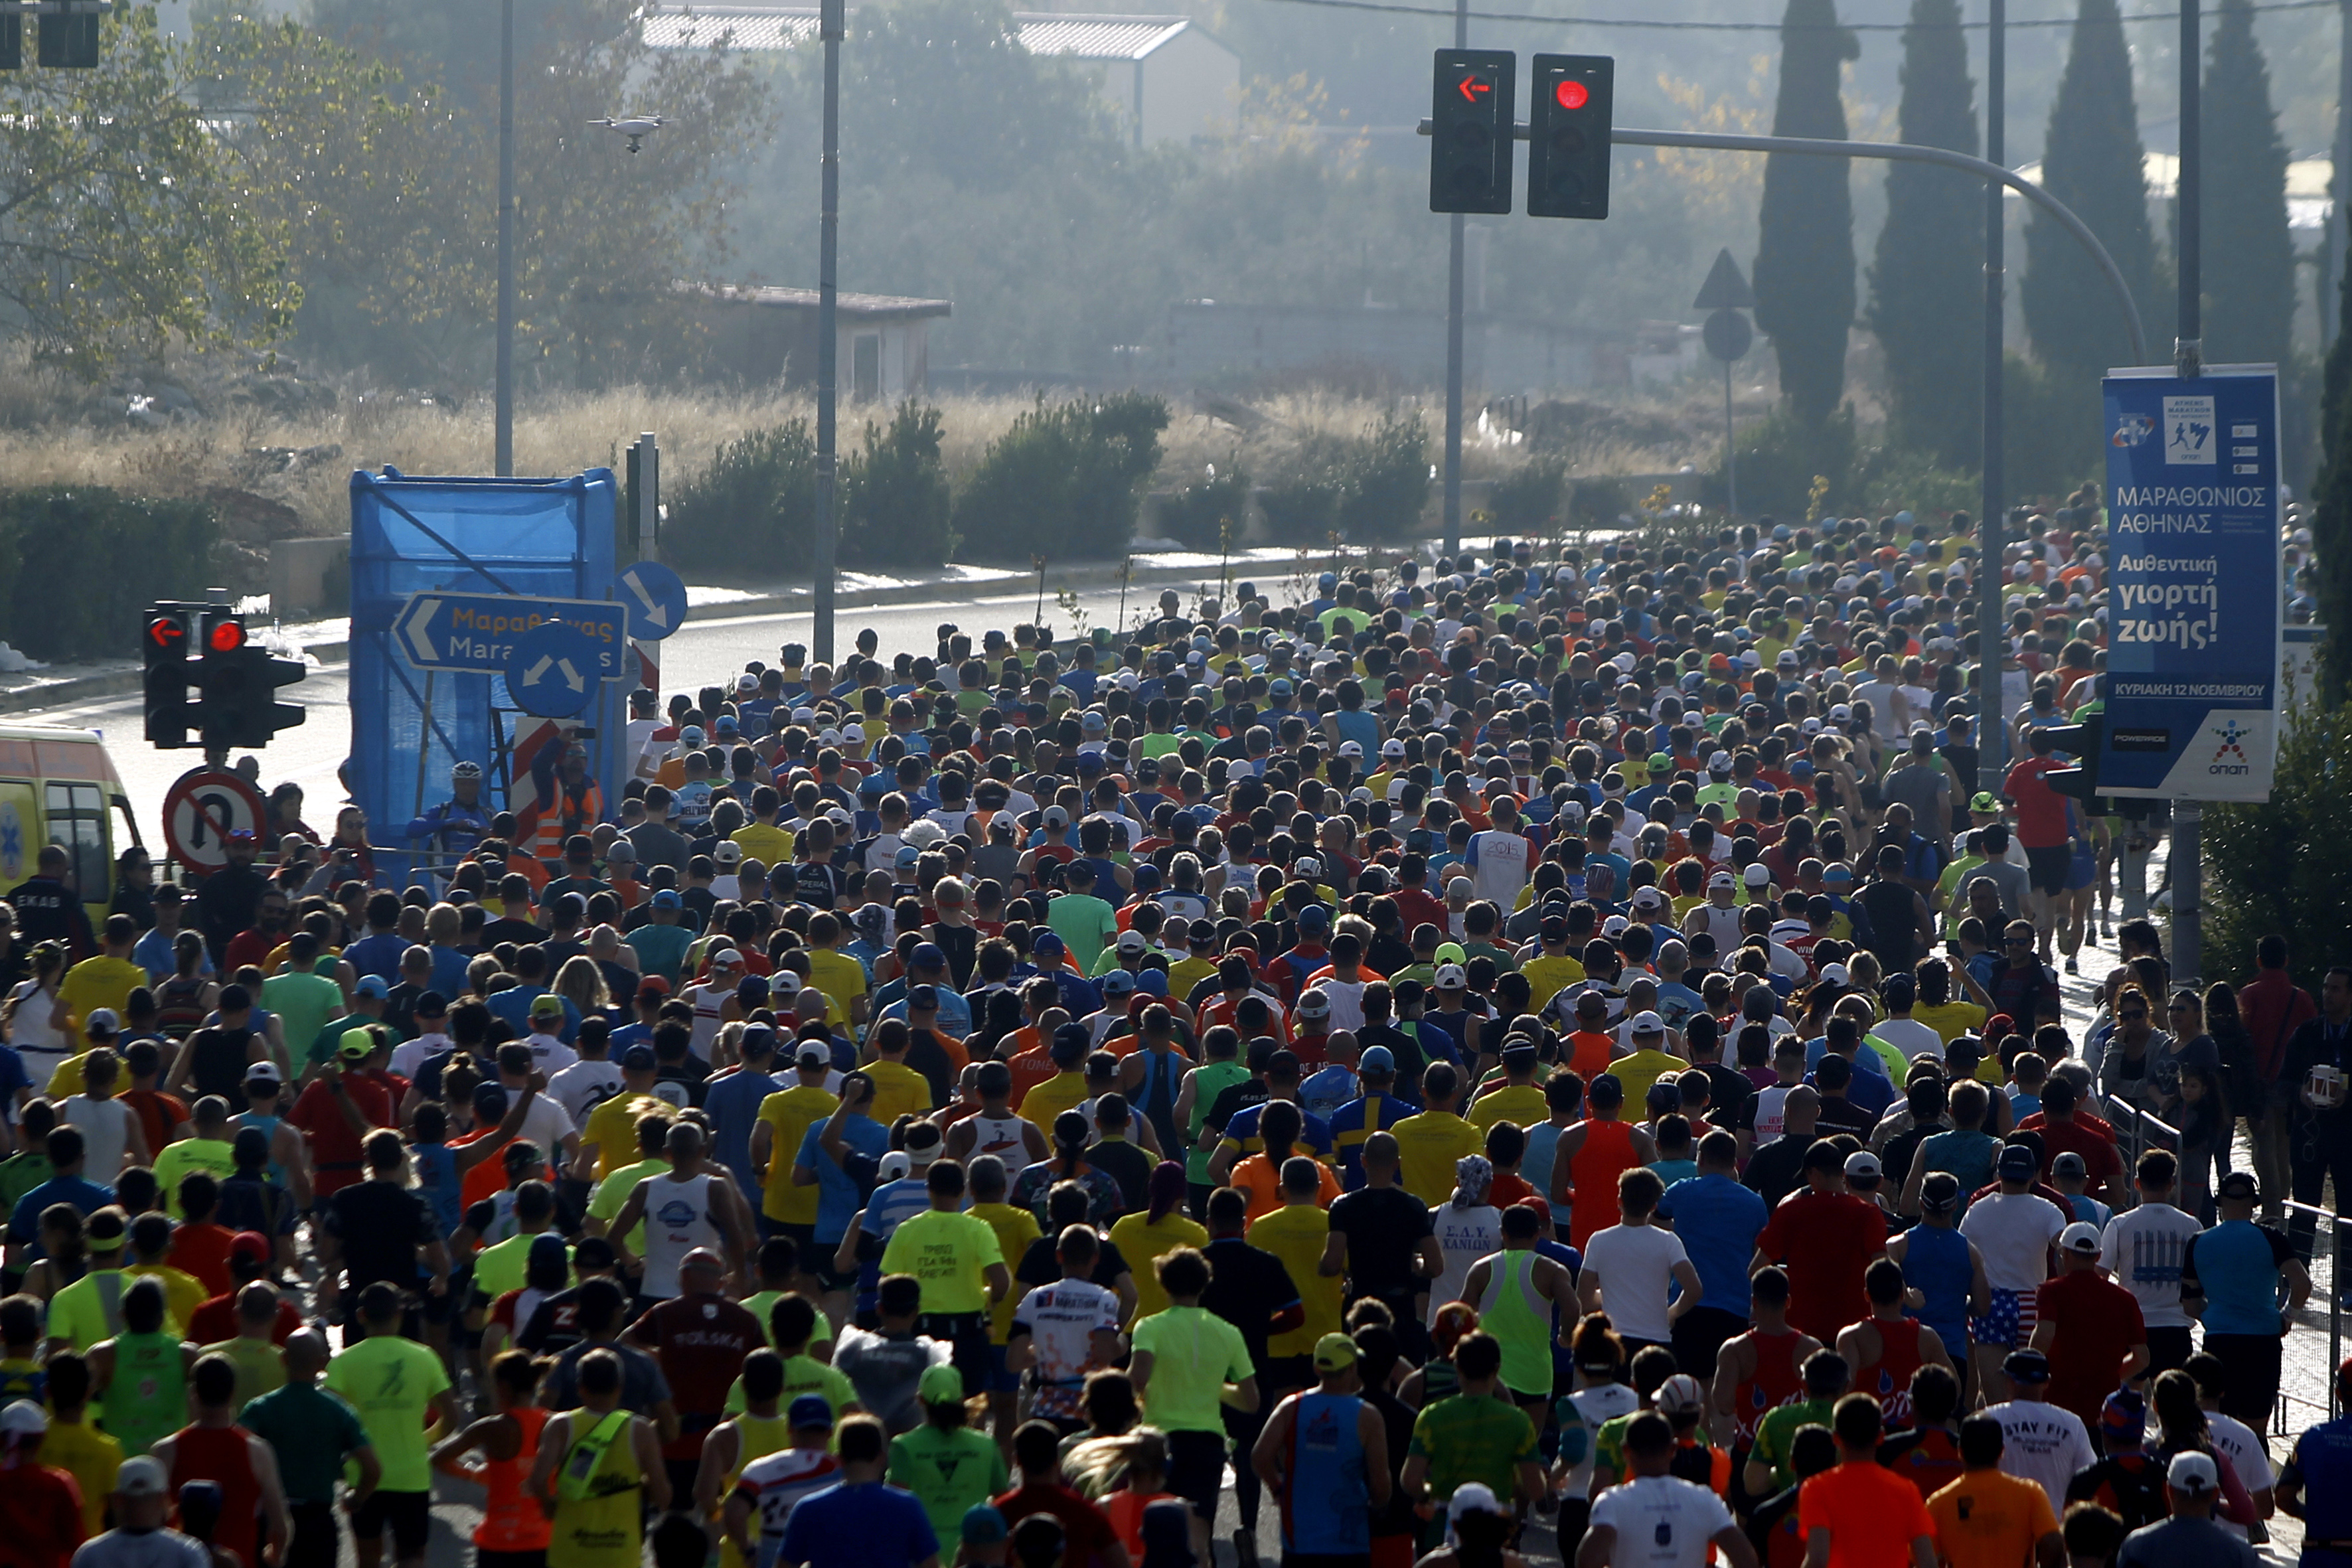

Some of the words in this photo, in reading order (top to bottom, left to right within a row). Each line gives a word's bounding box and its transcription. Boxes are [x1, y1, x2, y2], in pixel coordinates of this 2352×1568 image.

[2117, 487, 2266, 507] ΜΑΡΑΘΩΝΙΟΣ
[2117, 514, 2213, 533] ΑΘΗΝΑΣ
[2117, 554, 2217, 576] Αυθεντική
[2118, 578, 2217, 610] γιορτή
[453, 607, 614, 643] Μαραθας
[2117, 611, 2218, 649] ζωής!
[449, 635, 611, 667] Maras
[2116, 684, 2173, 695] ΚΥΡΙΑΚΗ
[2174, 684, 2187, 695] 12
[2189, 684, 2265, 696] ΝΟΕΜΒΡΙΟΥ
[1486, 840, 1519, 856] 2015
[1446, 1225, 1489, 1238] Σ.Δ.Υ.
[1443, 1238, 1491, 1251] ΧΑΝΙΩΝ
[554, 1306, 576, 1326] Z
[673, 1329, 745, 1352] POLSKA
[2004, 1422, 2039, 1436] STAY
[2047, 1423, 2070, 1440] FIT
[2221, 1437, 2242, 1456] FIT
